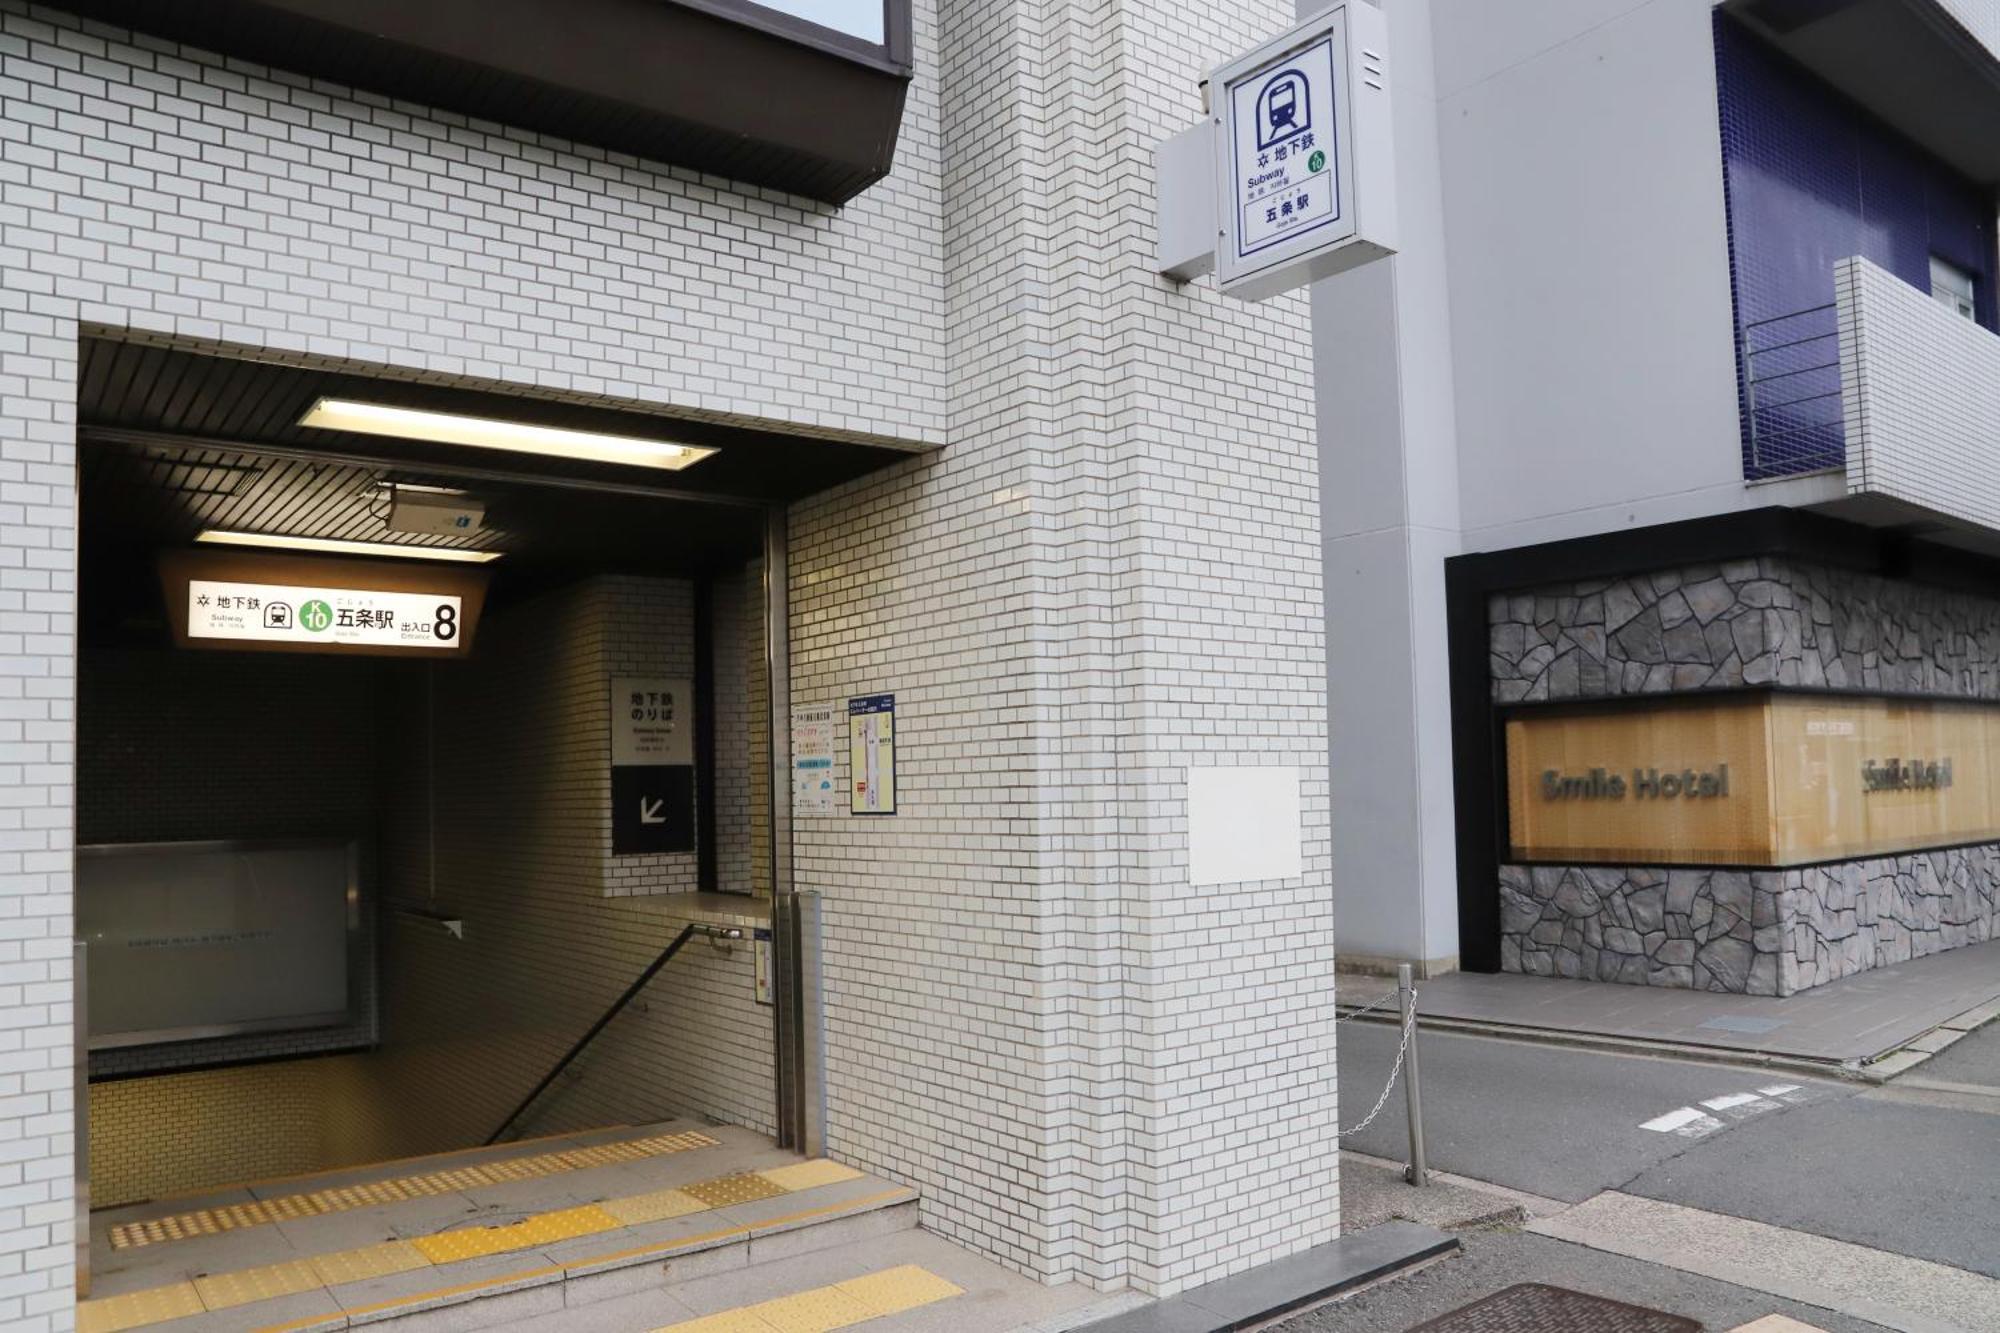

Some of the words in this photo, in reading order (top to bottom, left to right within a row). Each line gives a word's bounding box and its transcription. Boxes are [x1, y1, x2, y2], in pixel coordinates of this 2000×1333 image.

[1275, 132, 1314, 161] 地下鉄
[1312, 158, 1322, 171] 10
[1248, 166, 1285, 188] Subway
[1266, 194, 1309, 223] 五条駅
[217, 594, 260, 610] 地下鉄
[311, 602, 321, 612] K
[211, 614, 243, 623] Subway
[306, 612, 328, 628] 10
[336, 608, 394, 630] 五条駅
[433, 604, 456, 641] 8
[401, 622, 430, 633] 出入口
[631, 692, 673, 706] 地下鉄
[631, 708, 673, 721] のりば
[1543, 767, 1625, 801] Smile
[1634, 763, 1729, 799] Hotel
